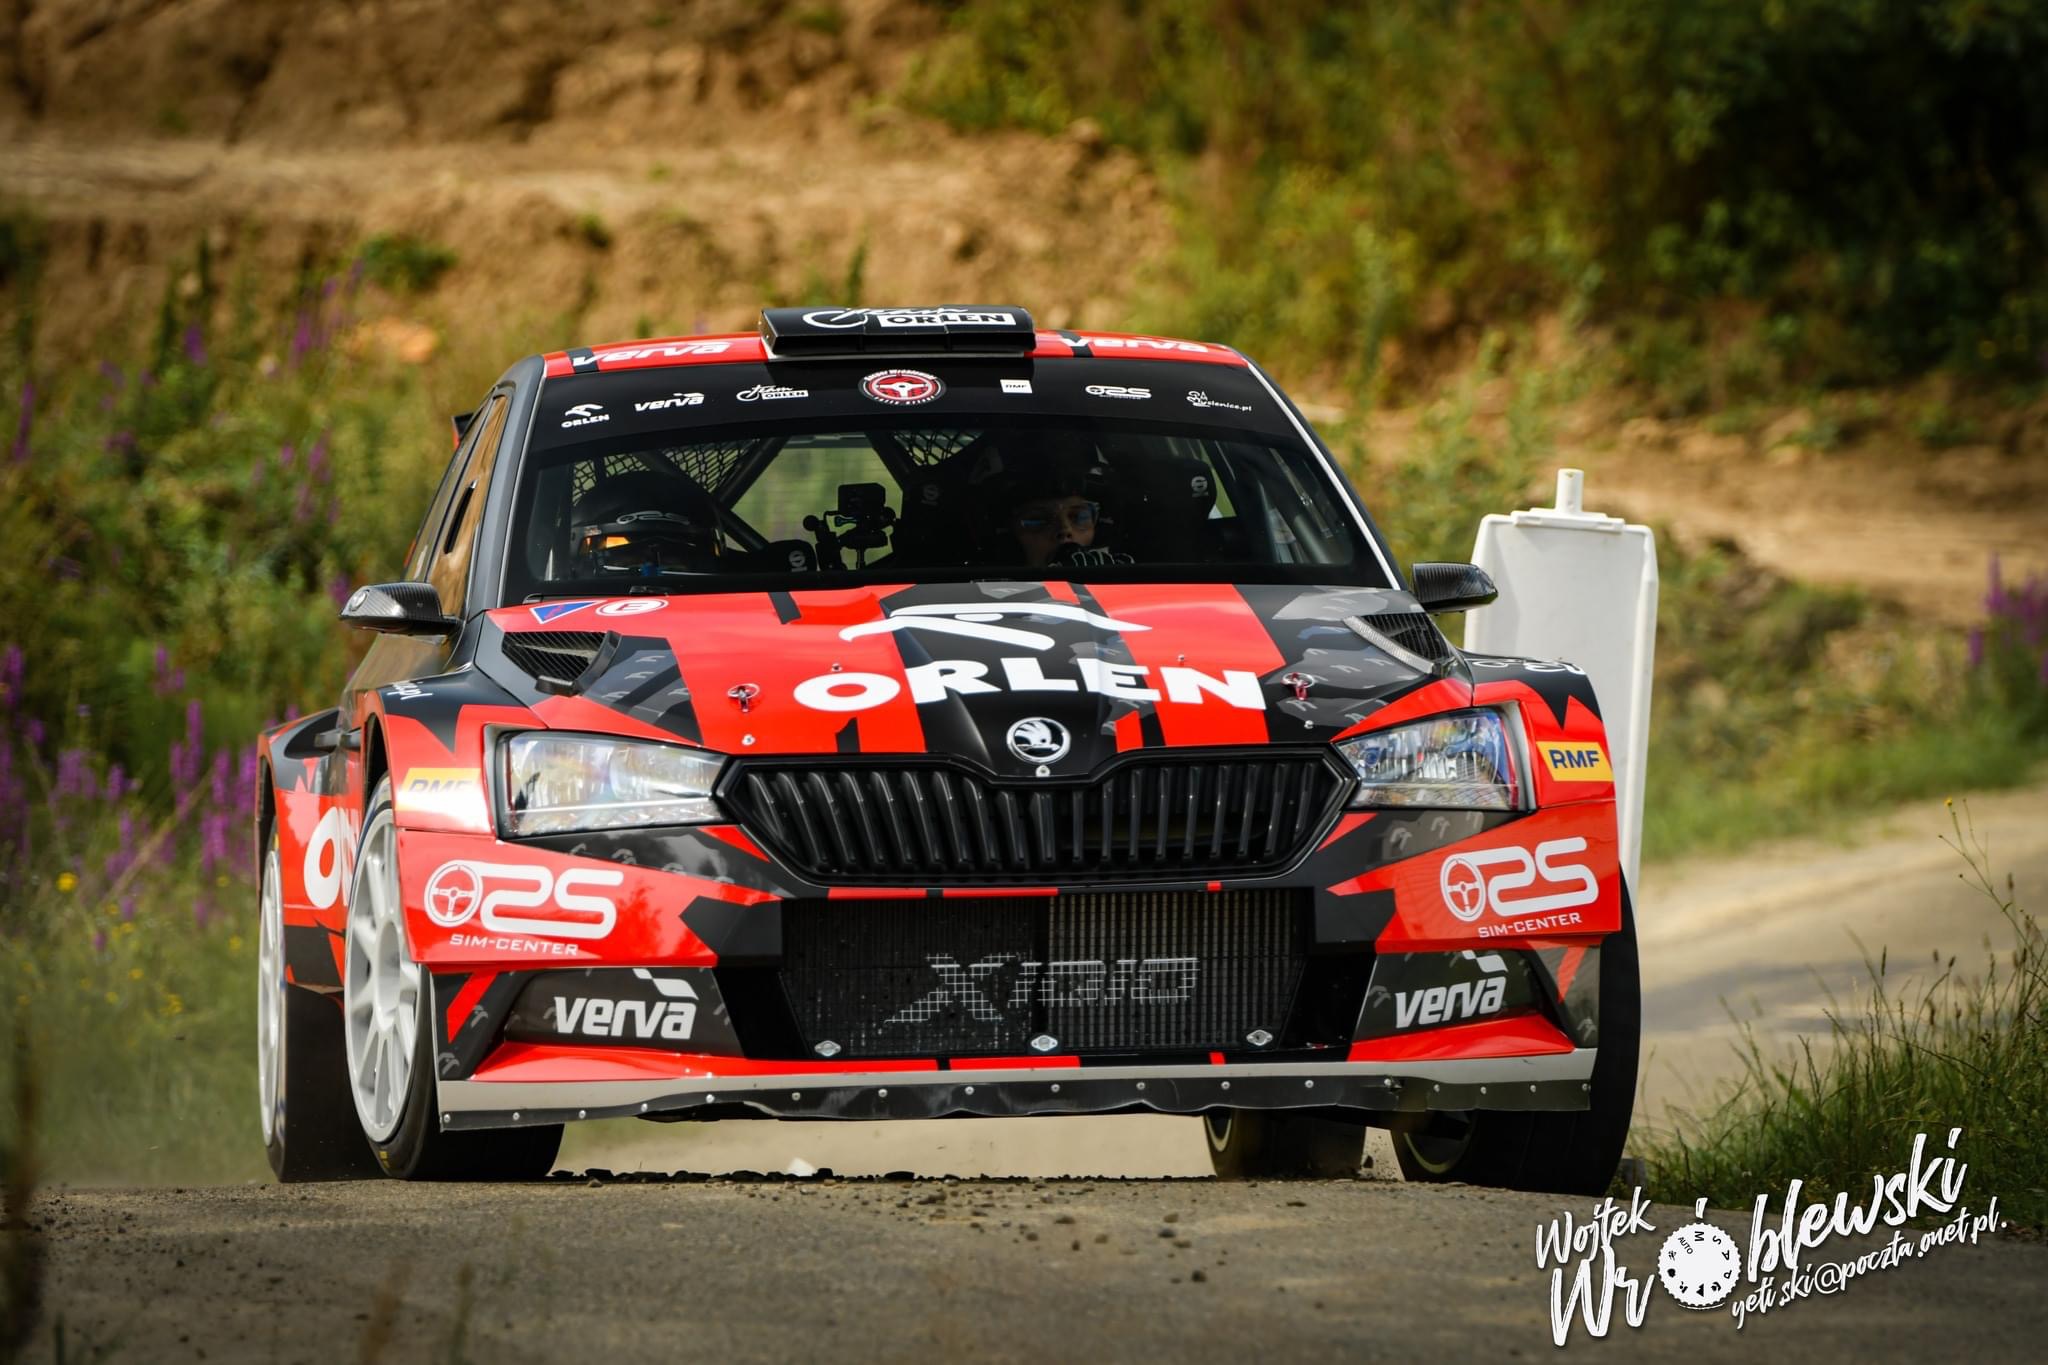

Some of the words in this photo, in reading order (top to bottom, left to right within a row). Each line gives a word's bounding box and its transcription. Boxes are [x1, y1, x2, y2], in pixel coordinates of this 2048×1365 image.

[885, 313, 1008, 325] ORLEN
[573, 341, 732, 366] verva
[1059, 336, 1209, 353] verva
[634, 397, 705, 411] verva
[561, 414, 610, 428] ORLEN
[794, 657, 1267, 711] ORLEN
[1548, 748, 1600, 771] RMF
[1478, 911, 1583, 938] SIM-CENTER
[449, 933, 579, 956] SIM-CENTER
[1394, 975, 1507, 1029] verva
[554, 996, 699, 1040] verva
